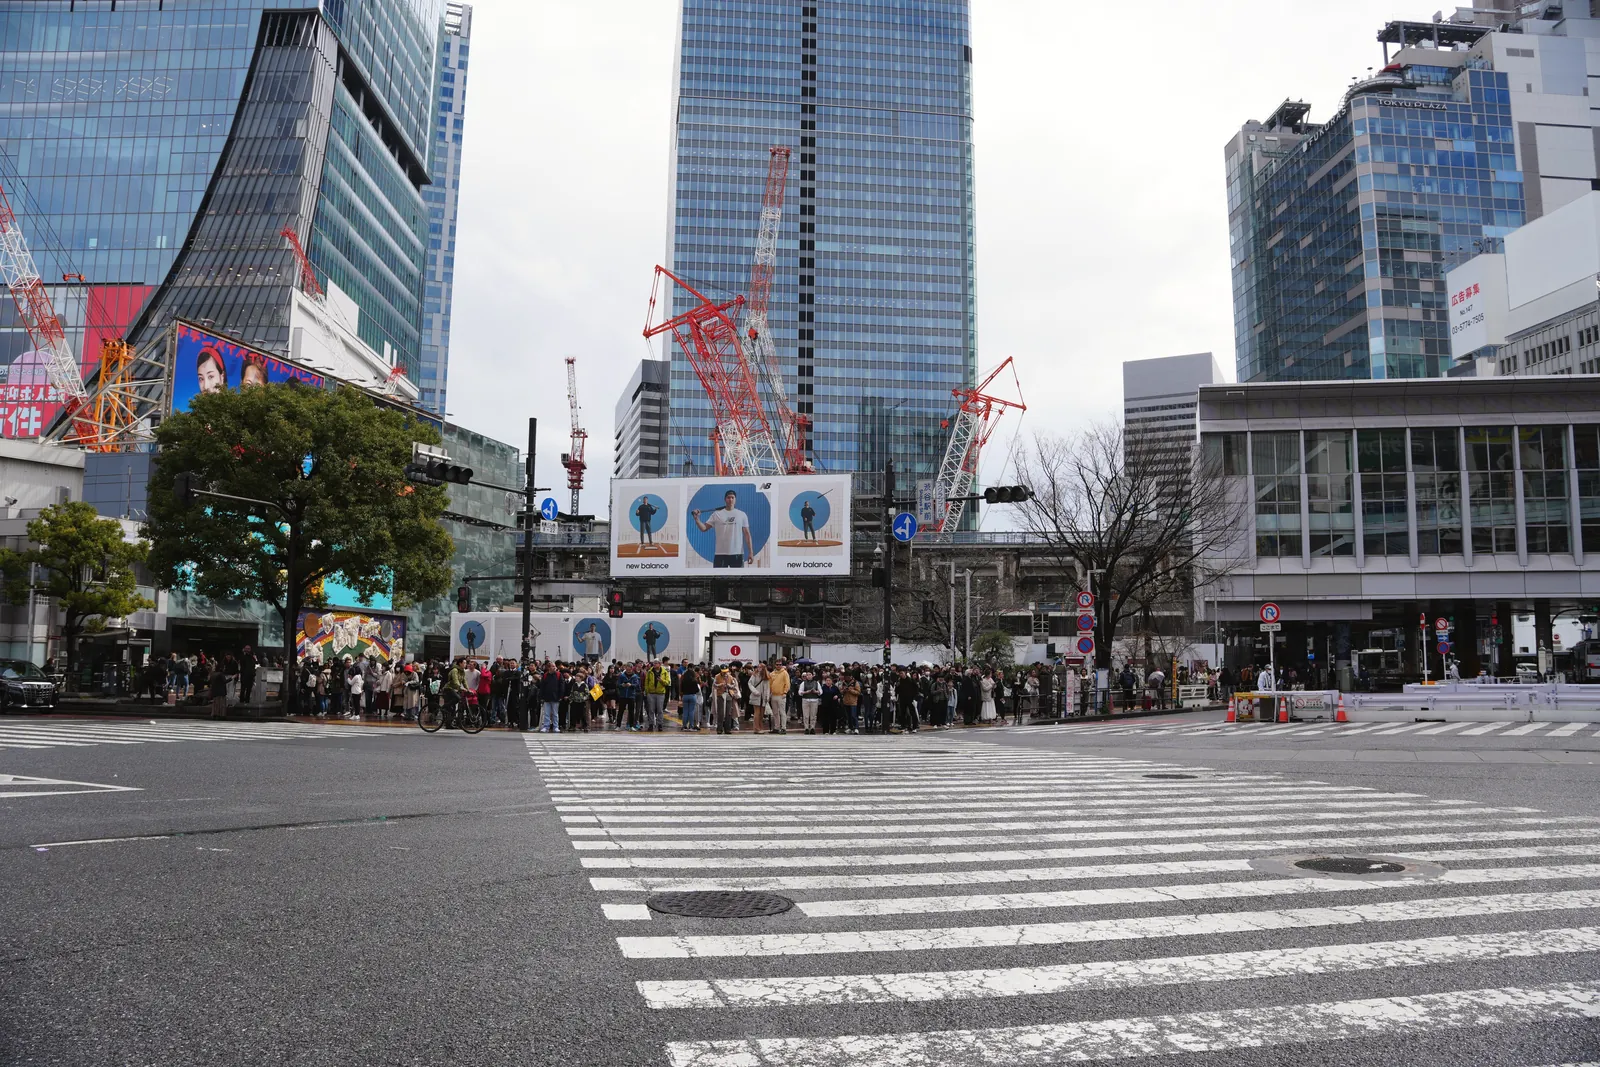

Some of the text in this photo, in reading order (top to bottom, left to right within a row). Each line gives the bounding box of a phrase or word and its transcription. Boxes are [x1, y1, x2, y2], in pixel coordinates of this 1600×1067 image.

[1378, 98, 1447, 110] TOKYU PLAZA
[1310, 108, 1346, 146] FUKURAS
[1452, 283, 1480, 307] 広告募集
[641, 562, 669, 570] balance
